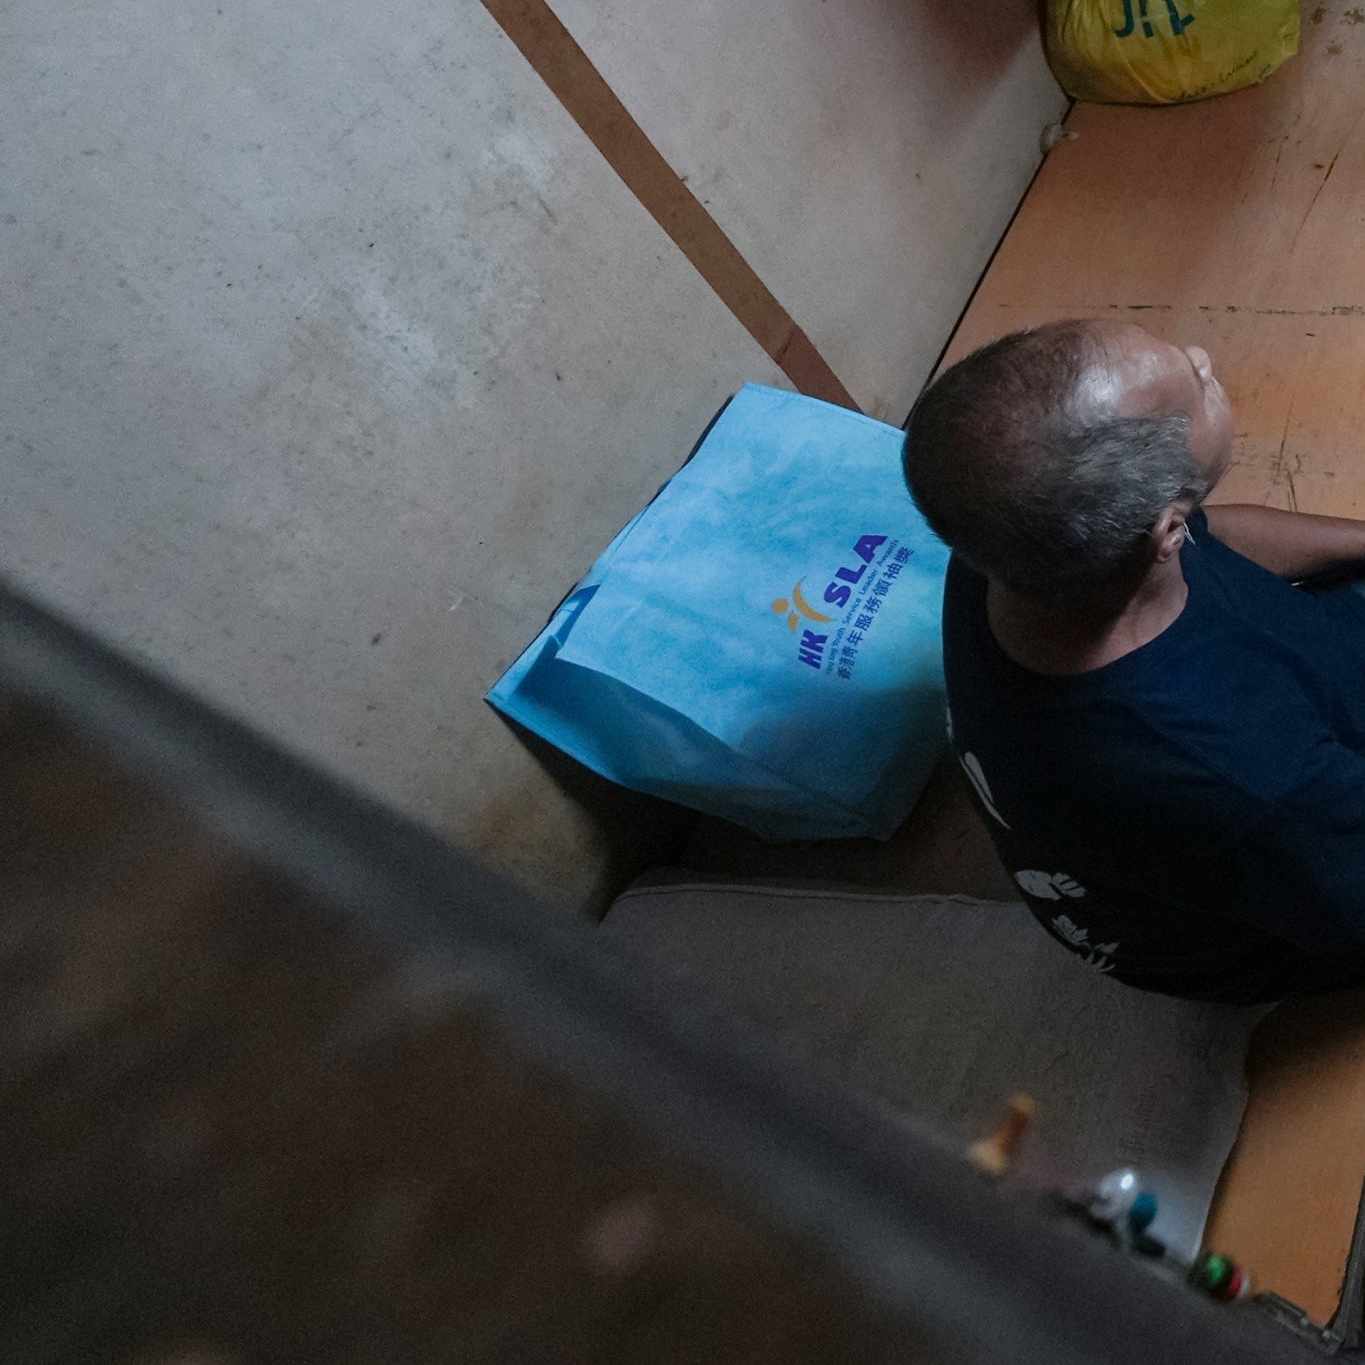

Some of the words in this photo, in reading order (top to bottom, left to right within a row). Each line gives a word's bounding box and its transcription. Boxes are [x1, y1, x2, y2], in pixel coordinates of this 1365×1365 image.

[798, 629, 828, 669] HK
[824, 535, 888, 608] SLA
[832, 627, 845, 648] Youth
[842, 597, 862, 625] Service
[858, 569, 878, 595] Leader
[877, 539, 899, 566] Awards
[837, 546, 915, 679] 香港青年服務領袖獎
